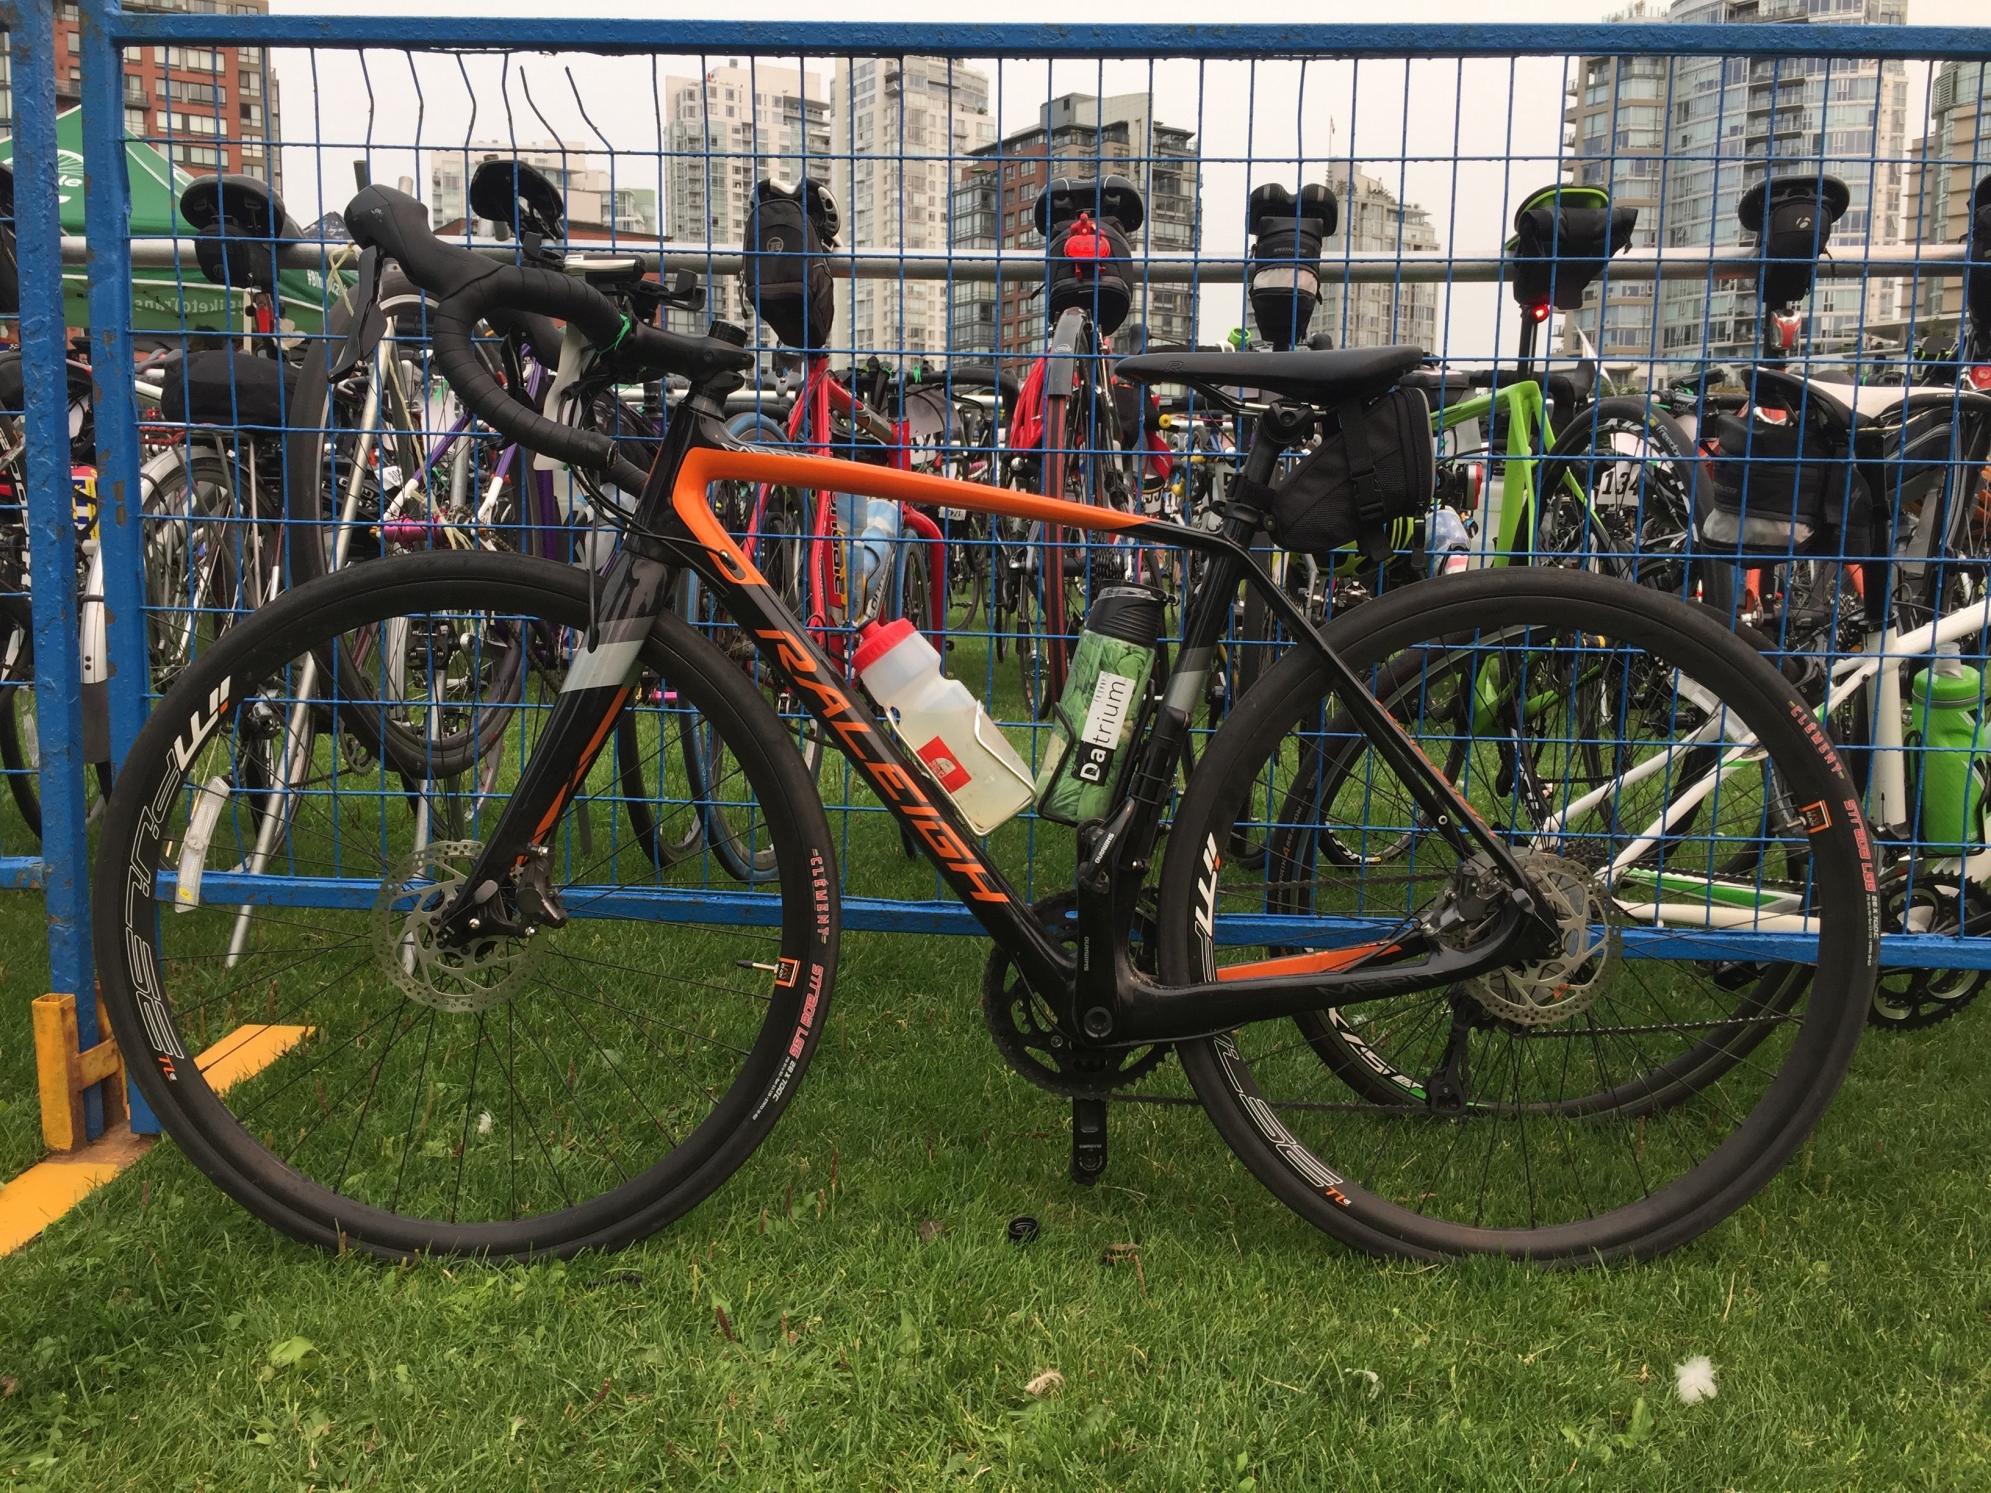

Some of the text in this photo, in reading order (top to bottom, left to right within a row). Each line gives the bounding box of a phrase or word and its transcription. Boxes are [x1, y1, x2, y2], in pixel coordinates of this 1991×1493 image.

[1602, 471, 1638, 496] 134
[1080, 681, 1126, 781] Datrium
[755, 629, 1010, 904] RALEIGH
[773, 1080, 789, 1102] 700C
